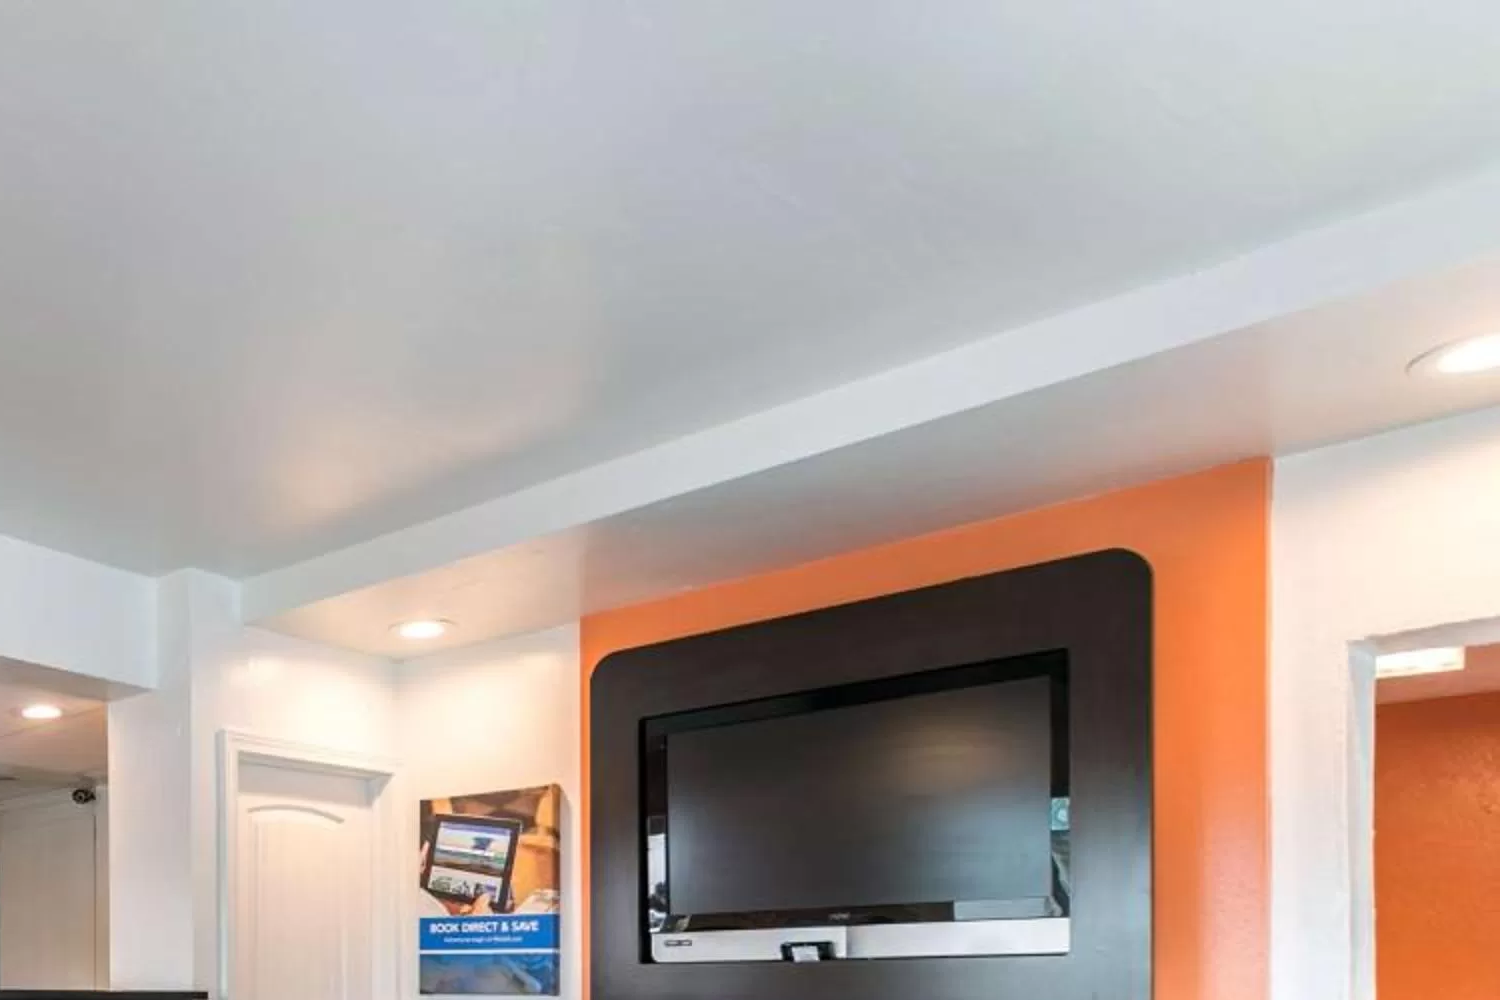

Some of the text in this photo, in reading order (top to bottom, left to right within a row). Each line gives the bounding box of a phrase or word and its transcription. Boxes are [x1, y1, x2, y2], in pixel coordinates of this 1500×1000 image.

[429, 919, 539, 934] BOOK DIRECT & SAVE
